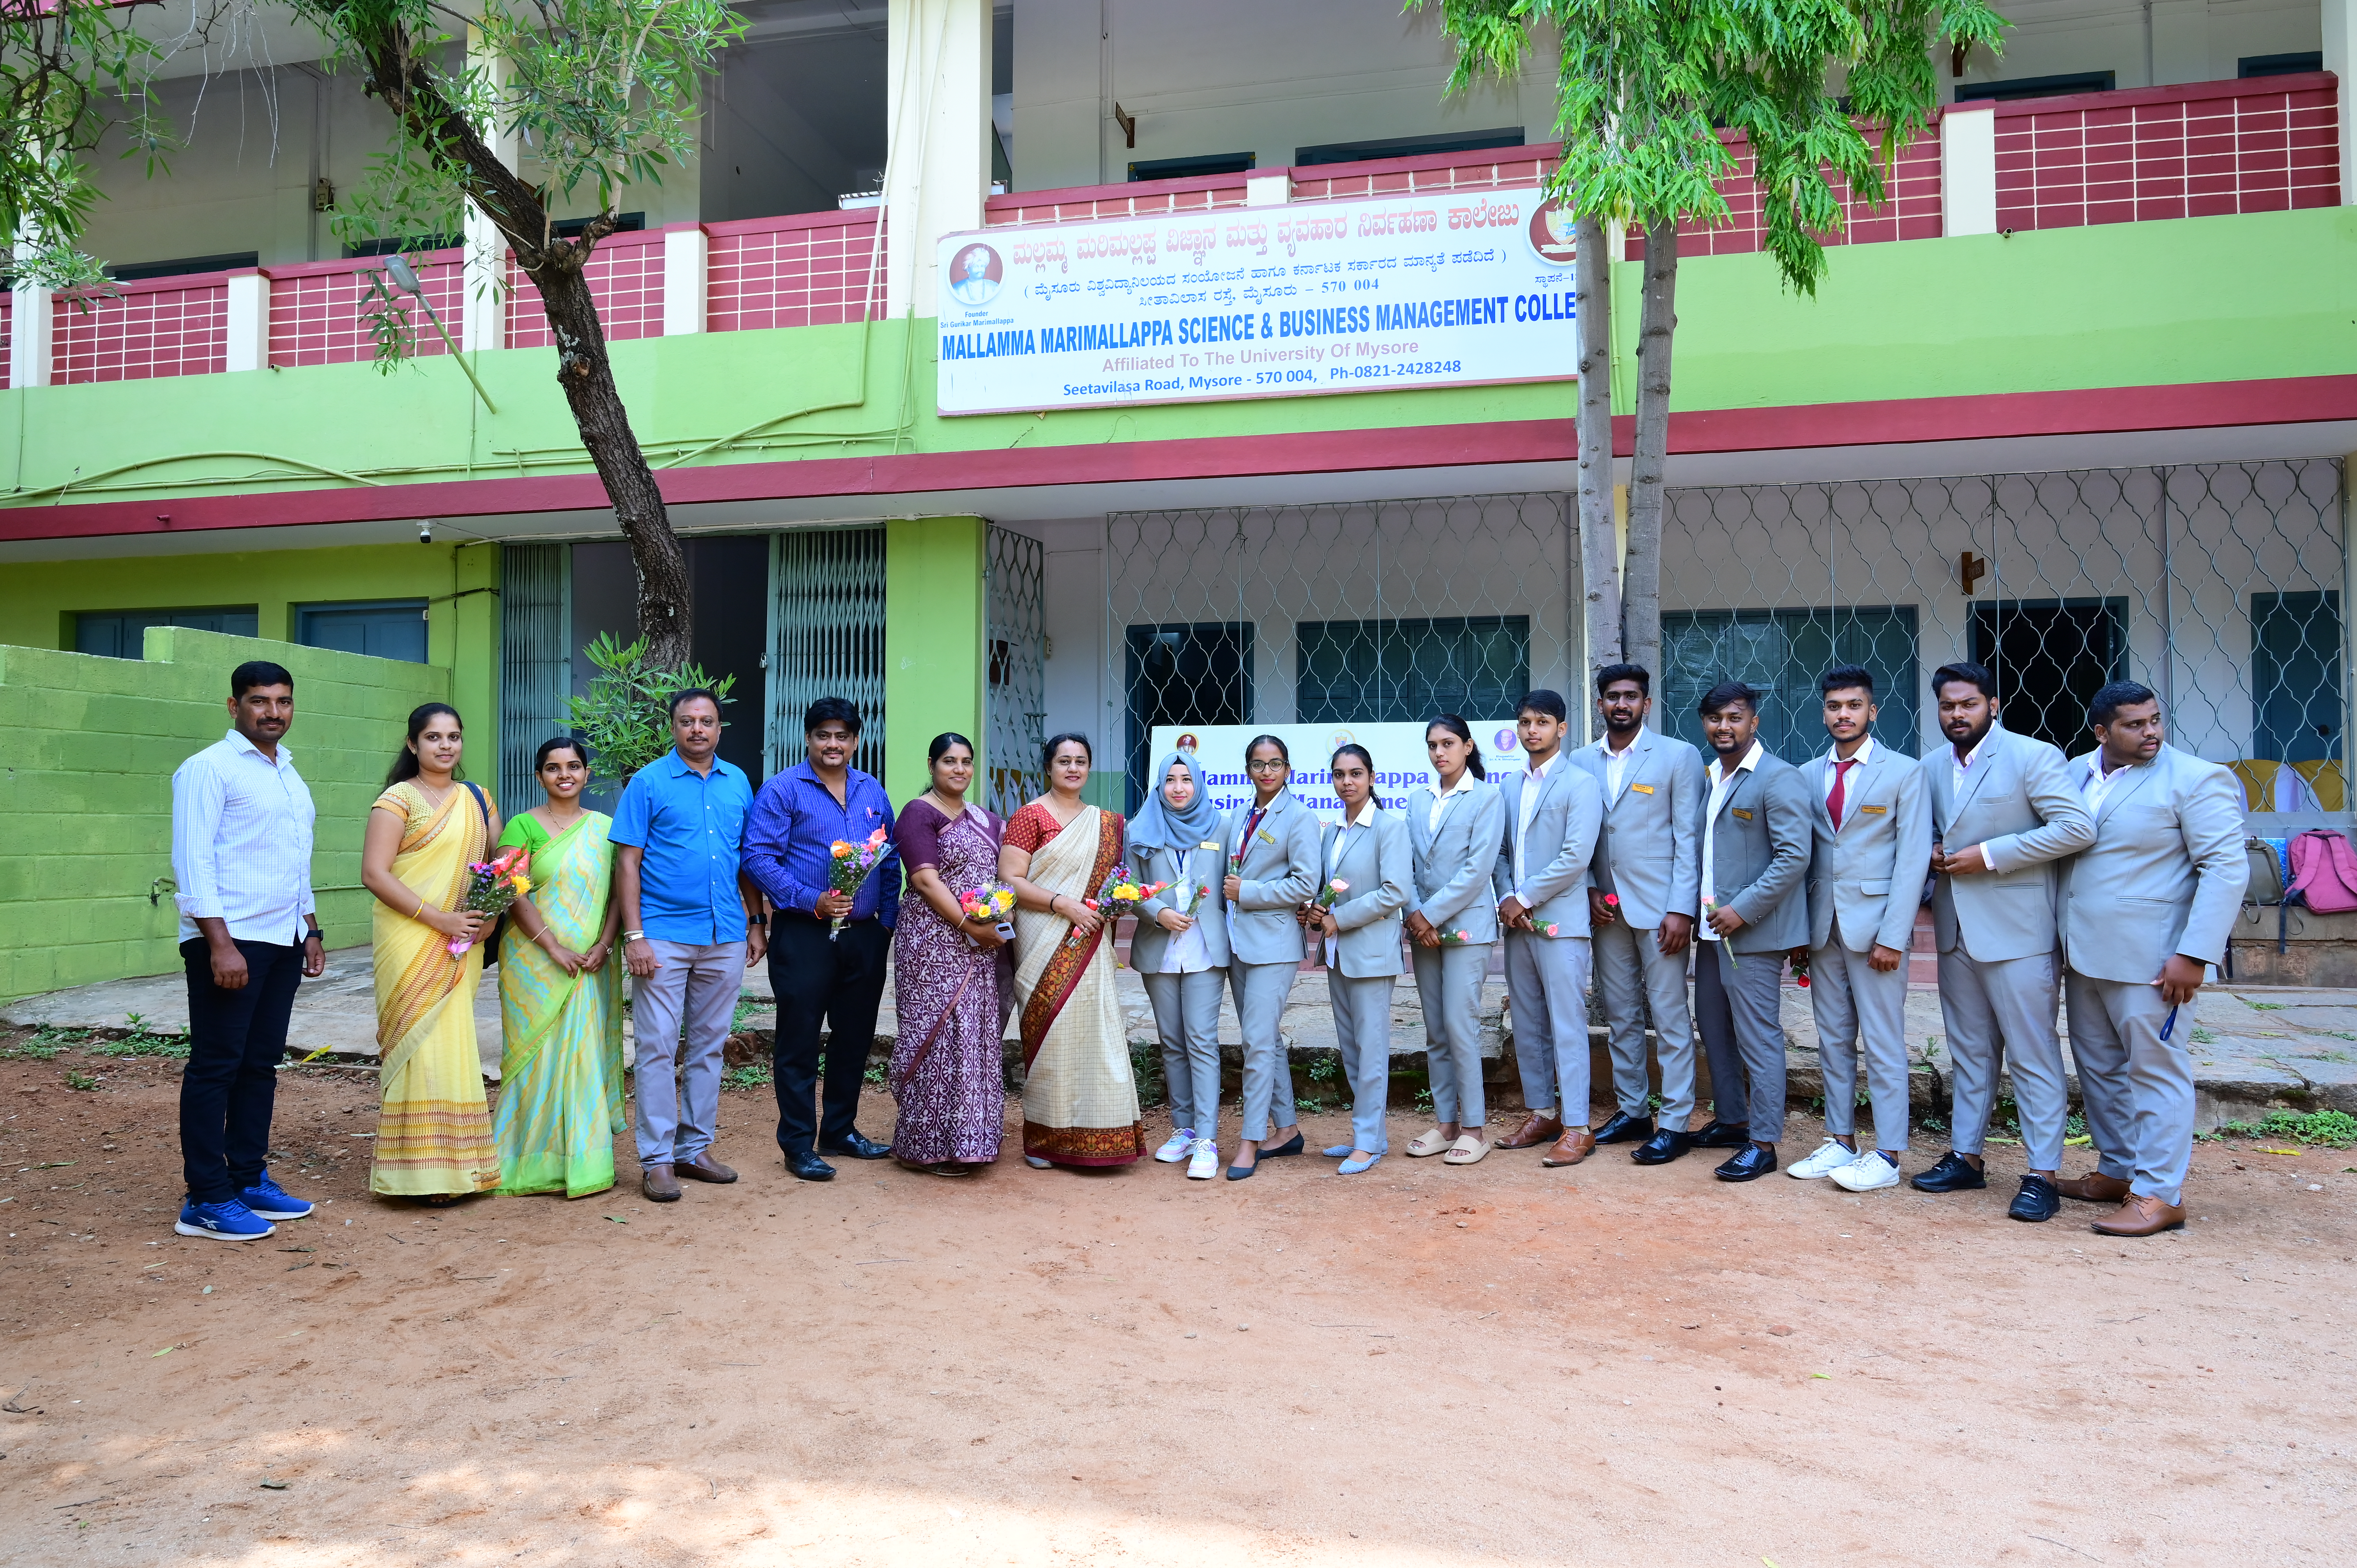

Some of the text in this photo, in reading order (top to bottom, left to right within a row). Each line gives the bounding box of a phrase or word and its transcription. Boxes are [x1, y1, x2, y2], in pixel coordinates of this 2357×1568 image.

[1118, 108, 1131, 135] OFFICE
[1013, 198, 1519, 274] ಮಲ್ಲಮ್ಮ ಮರಿಮಲ್ಲಪ್ಪ ವಿಜ್ಞಾನ ಮತ್ತು ವ್ಯವಹಾರ ನಿರ್ವಹಣಾ ಕಾಲೇಜು
[1035, 281, 1080, 301] ಮೈಸೂರು
[1087, 273, 1175, 296] ವಿಶ್ವವಿದ್ಯಾನಿಲಯದ
[1182, 267, 1244, 284] ಸಂಯೋಜನೆ
[1251, 265, 1286, 278] ಹಾಗೂ
[1293, 261, 1341, 275] ಕರ್ನಾಟಕ
[1348, 256, 1396, 271] ಸರ್ಕಾರದ
[1404, 252, 1444, 272] ಮಾನ್ಯತೆ
[1452, 249, 1494, 263] ಪಡೆದಿದೆ
[1139, 290, 1206, 306] ಸೀತಾವಿಲಾಸ
[1214, 288, 1235, 306] ರಸ್ತೆ,
[1244, 284, 1297, 305] ಮೈಸೂರು
[1322, 281, 1346, 293] 570
[1354, 278, 1379, 290] 004
[943, 292, 1576, 360] MALLAMMA MARIMALLAPPA SCIENCE & BUSINESS MANAGEMENT COLLE
[1103, 342, 1418, 372] Affiliated To The University Of Mysore
[1064, 381, 1140, 396] Seetavilasa
[1145, 377, 1184, 391] Road,
[1189, 376, 1242, 390] Mysore
[1256, 371, 1282, 384] 570
[1286, 369, 1317, 383] 004,
[1331, 360, 1461, 379] Ph-0821-2428248
